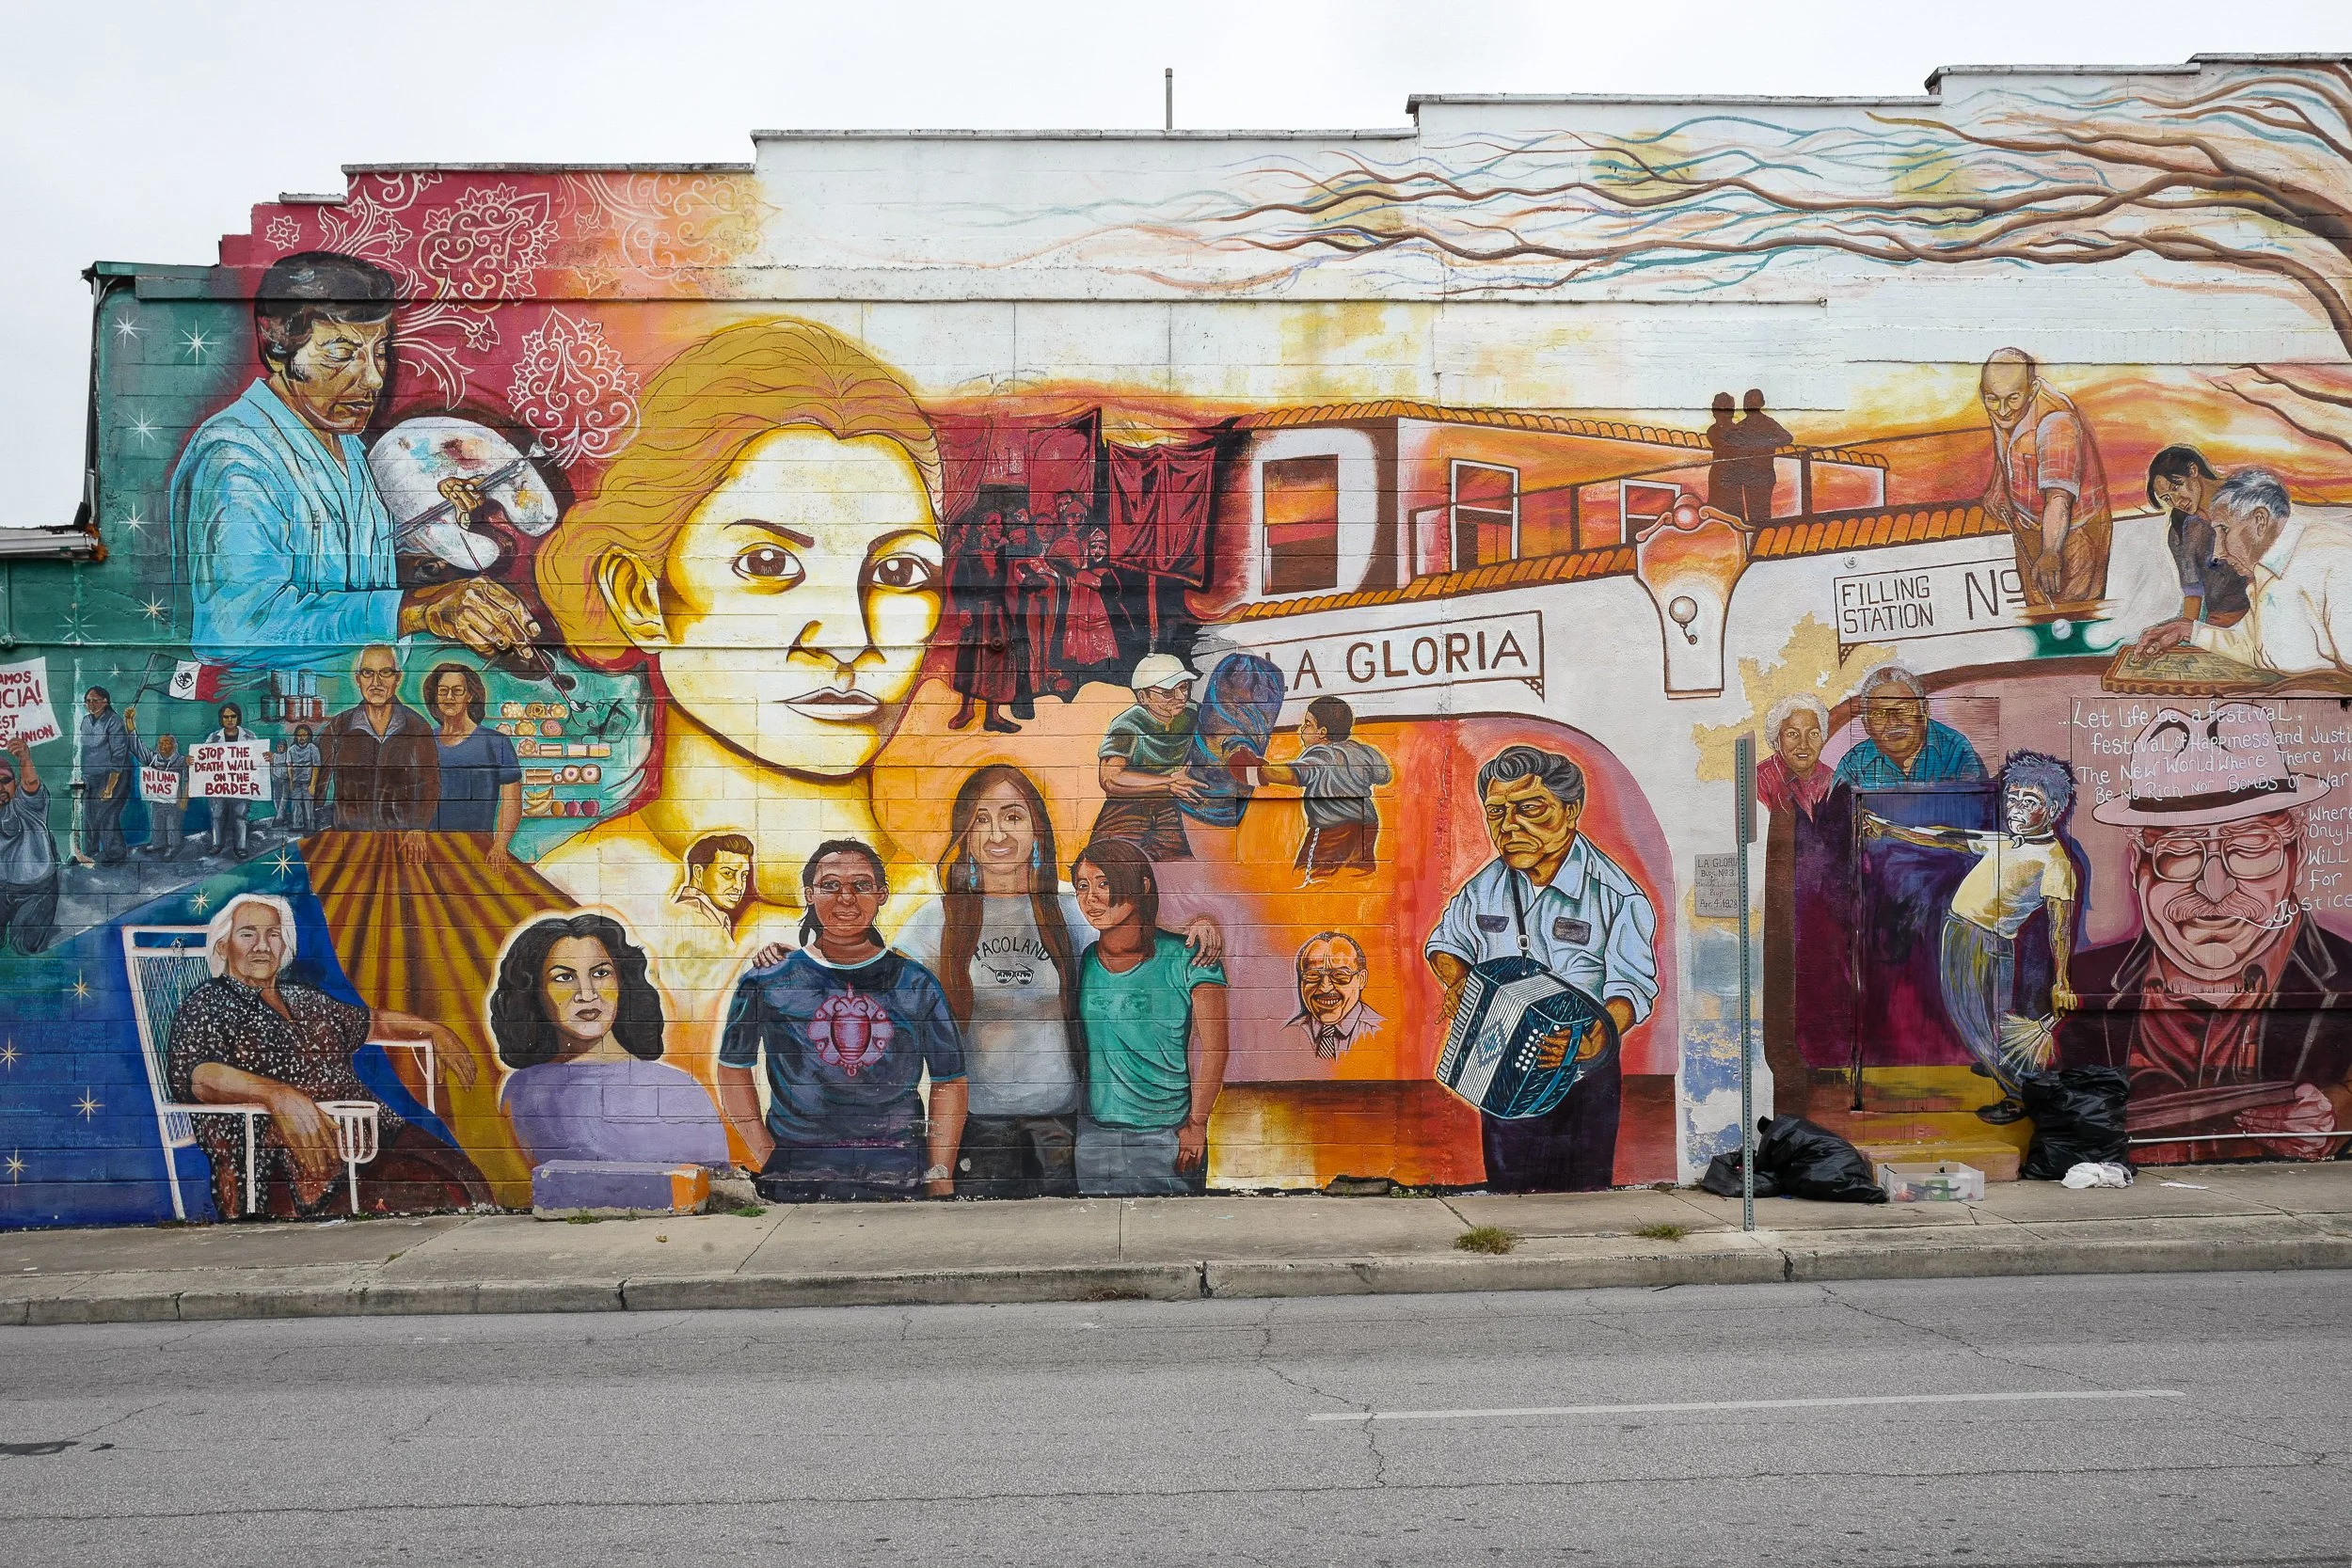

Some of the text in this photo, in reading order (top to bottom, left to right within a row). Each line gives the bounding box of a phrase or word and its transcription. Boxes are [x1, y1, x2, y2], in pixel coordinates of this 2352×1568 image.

[1841, 575, 1931, 606] FILLING
[1843, 603, 1934, 634] STATION
[1346, 629, 1528, 683] GLORIA
[0, 679, 43, 708] CIA!
[2119, 705, 2149, 728] Life
[2155, 705, 2179, 723] be
[2191, 708, 2201, 723] a
[2174, 732, 2188, 749] of
[2189, 732, 2269, 755] Happiness
[2274, 725, 2303, 745] and
[198, 747, 250, 760] STOP THE
[143, 770, 177, 783] NI UNA
[194, 760, 257, 772] DEATH WALL
[214, 772, 250, 783] ON THE
[2075, 766, 2110, 785] The
[2120, 760, 2159, 781] New
[2276, 750, 2322, 766] There
[146, 784, 172, 795] MAS
[205, 783, 261, 796] BORDER
[2094, 786, 2114, 804] Be
[2121, 785, 2140, 800] No
[2145, 782, 2184, 801] Rich
[2288, 773, 2305, 788] or
[2317, 770, 2349, 789] War
[2308, 824, 2343, 846] Only
[1697, 859, 1709, 867] LA
[2310, 869, 2343, 892] For
[2273, 890, 2352, 923] Justice
